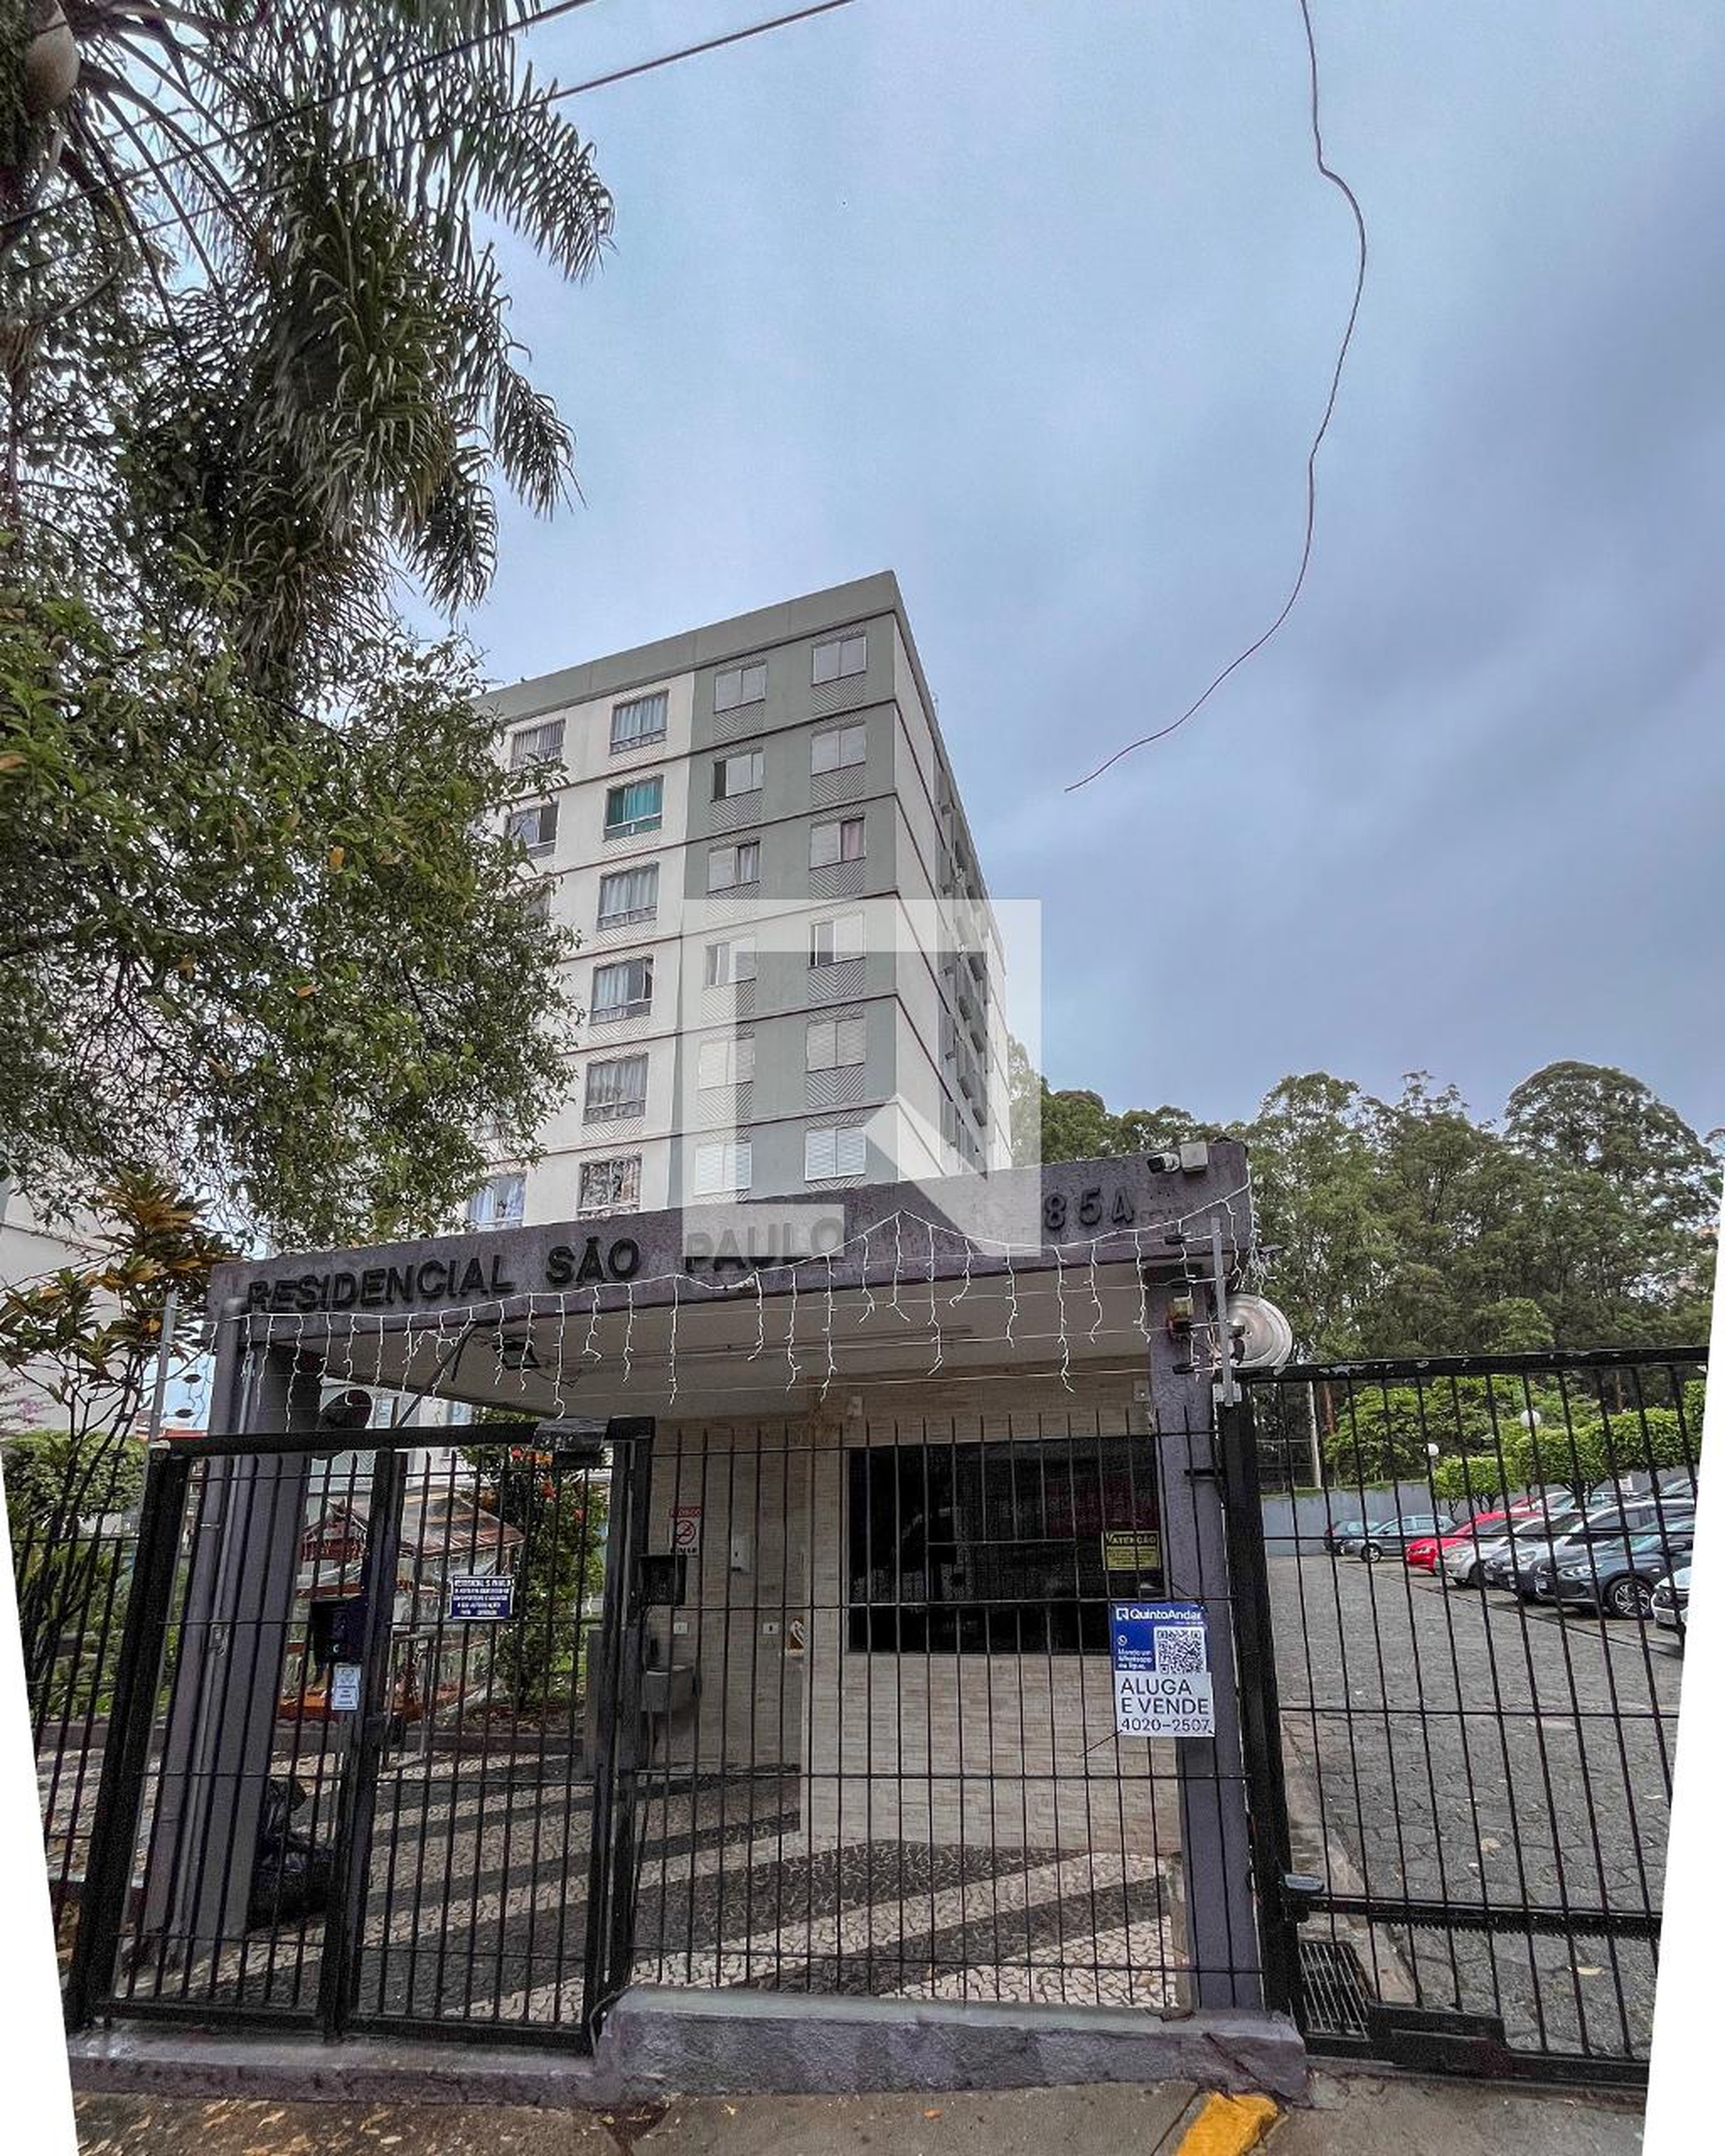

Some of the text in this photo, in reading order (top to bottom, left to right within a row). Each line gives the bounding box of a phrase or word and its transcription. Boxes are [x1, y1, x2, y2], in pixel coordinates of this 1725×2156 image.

[248, 1255, 515, 1313] RESIDENCIAL
[546, 1236, 640, 1285] SÃO
[686, 1217, 845, 1272] PAULO
[1130, 1608, 1202, 1620] QuintoAndar
[1120, 1678, 1192, 1695] ALUGA
[1122, 1698, 1208, 1715] E VENDE
[1122, 1719, 1210, 1732] 4020-2507
